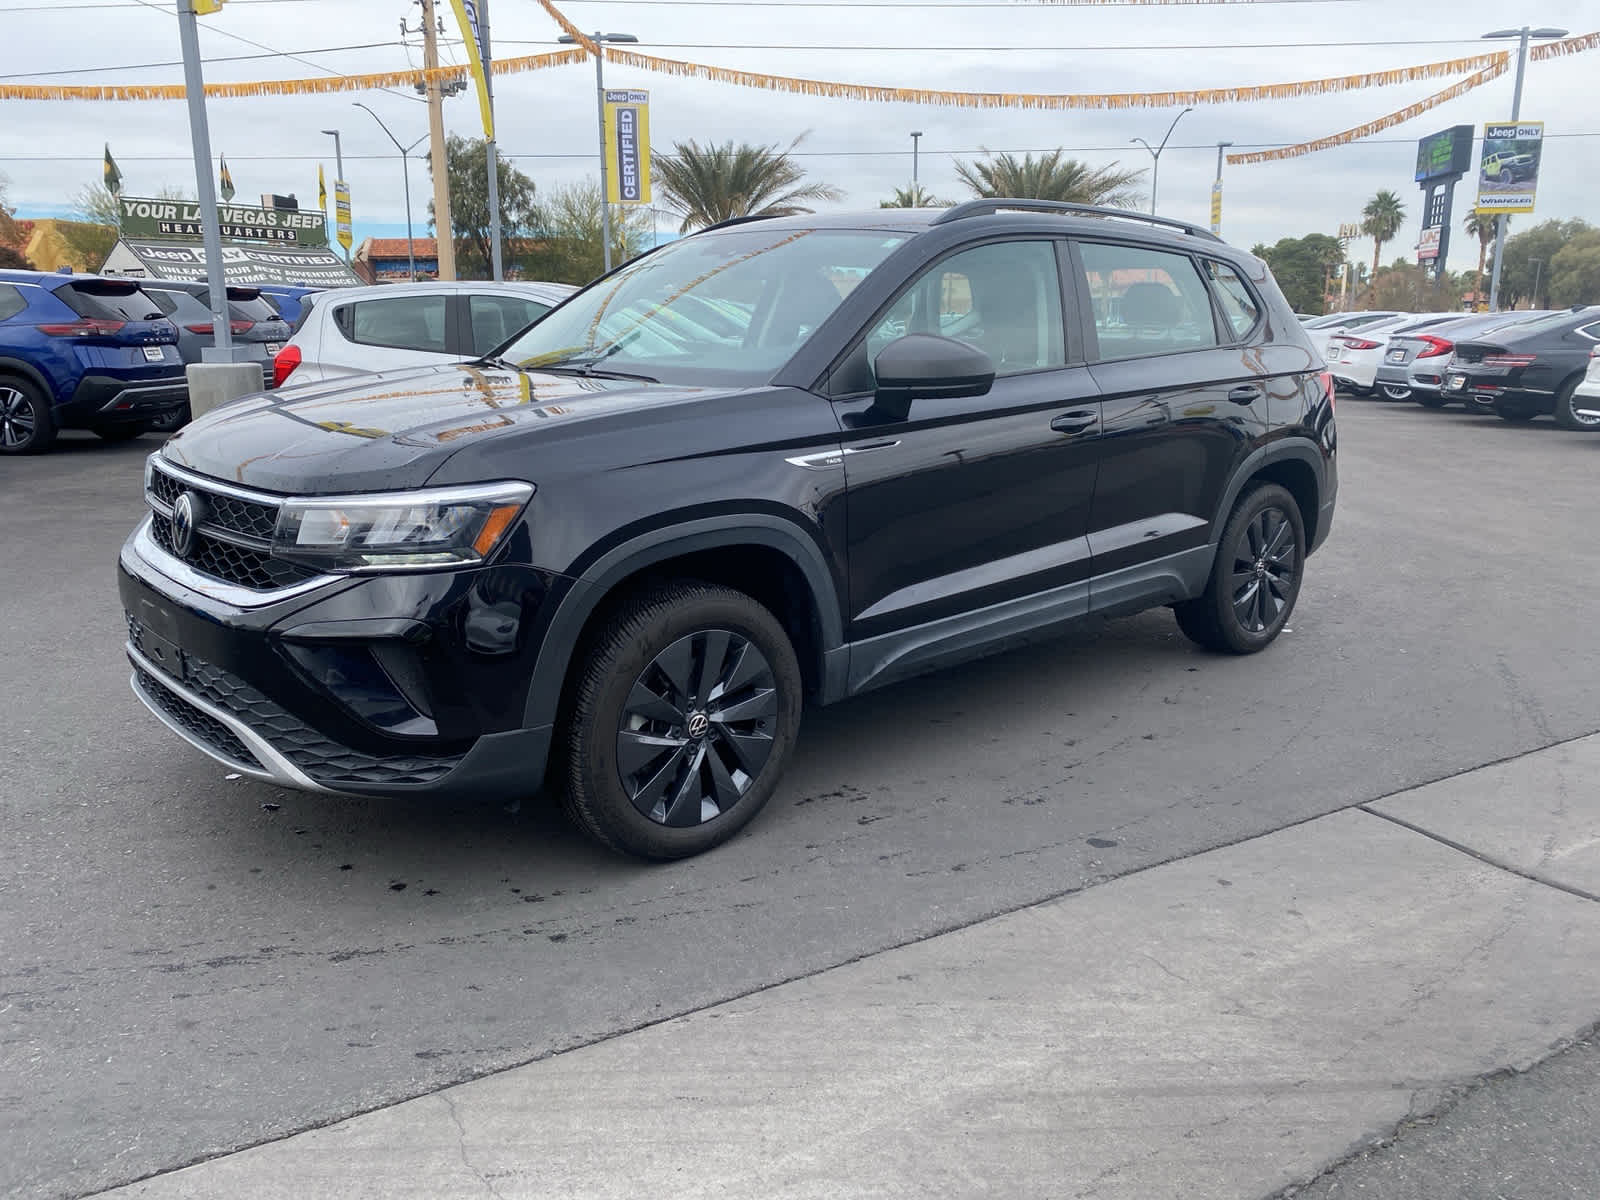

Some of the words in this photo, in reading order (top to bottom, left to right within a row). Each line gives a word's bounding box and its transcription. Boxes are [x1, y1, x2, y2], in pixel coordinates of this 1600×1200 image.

[607, 92, 627, 101] Jeep
[1489, 127, 1515, 137] Jeep
[1518, 128, 1540, 136] ONLY
[621, 110, 636, 198] CERTIFIED
[124, 202, 177, 220] YOUR
[183, 206, 204, 222] LA
[222, 209, 277, 226] VEGAS
[282, 214, 323, 229] JEEP
[161, 222, 296, 240] HEADUARTERS
[141, 247, 193, 261] Jeep
[198, 249, 241, 259] OLY
[246, 251, 337, 264] CERTIFIED
[159, 265, 208, 275] UNLEAS
[223, 265, 252, 275] OUR
[253, 264, 282, 275] NEXT
[285, 270, 348, 278] ADVENTURE
